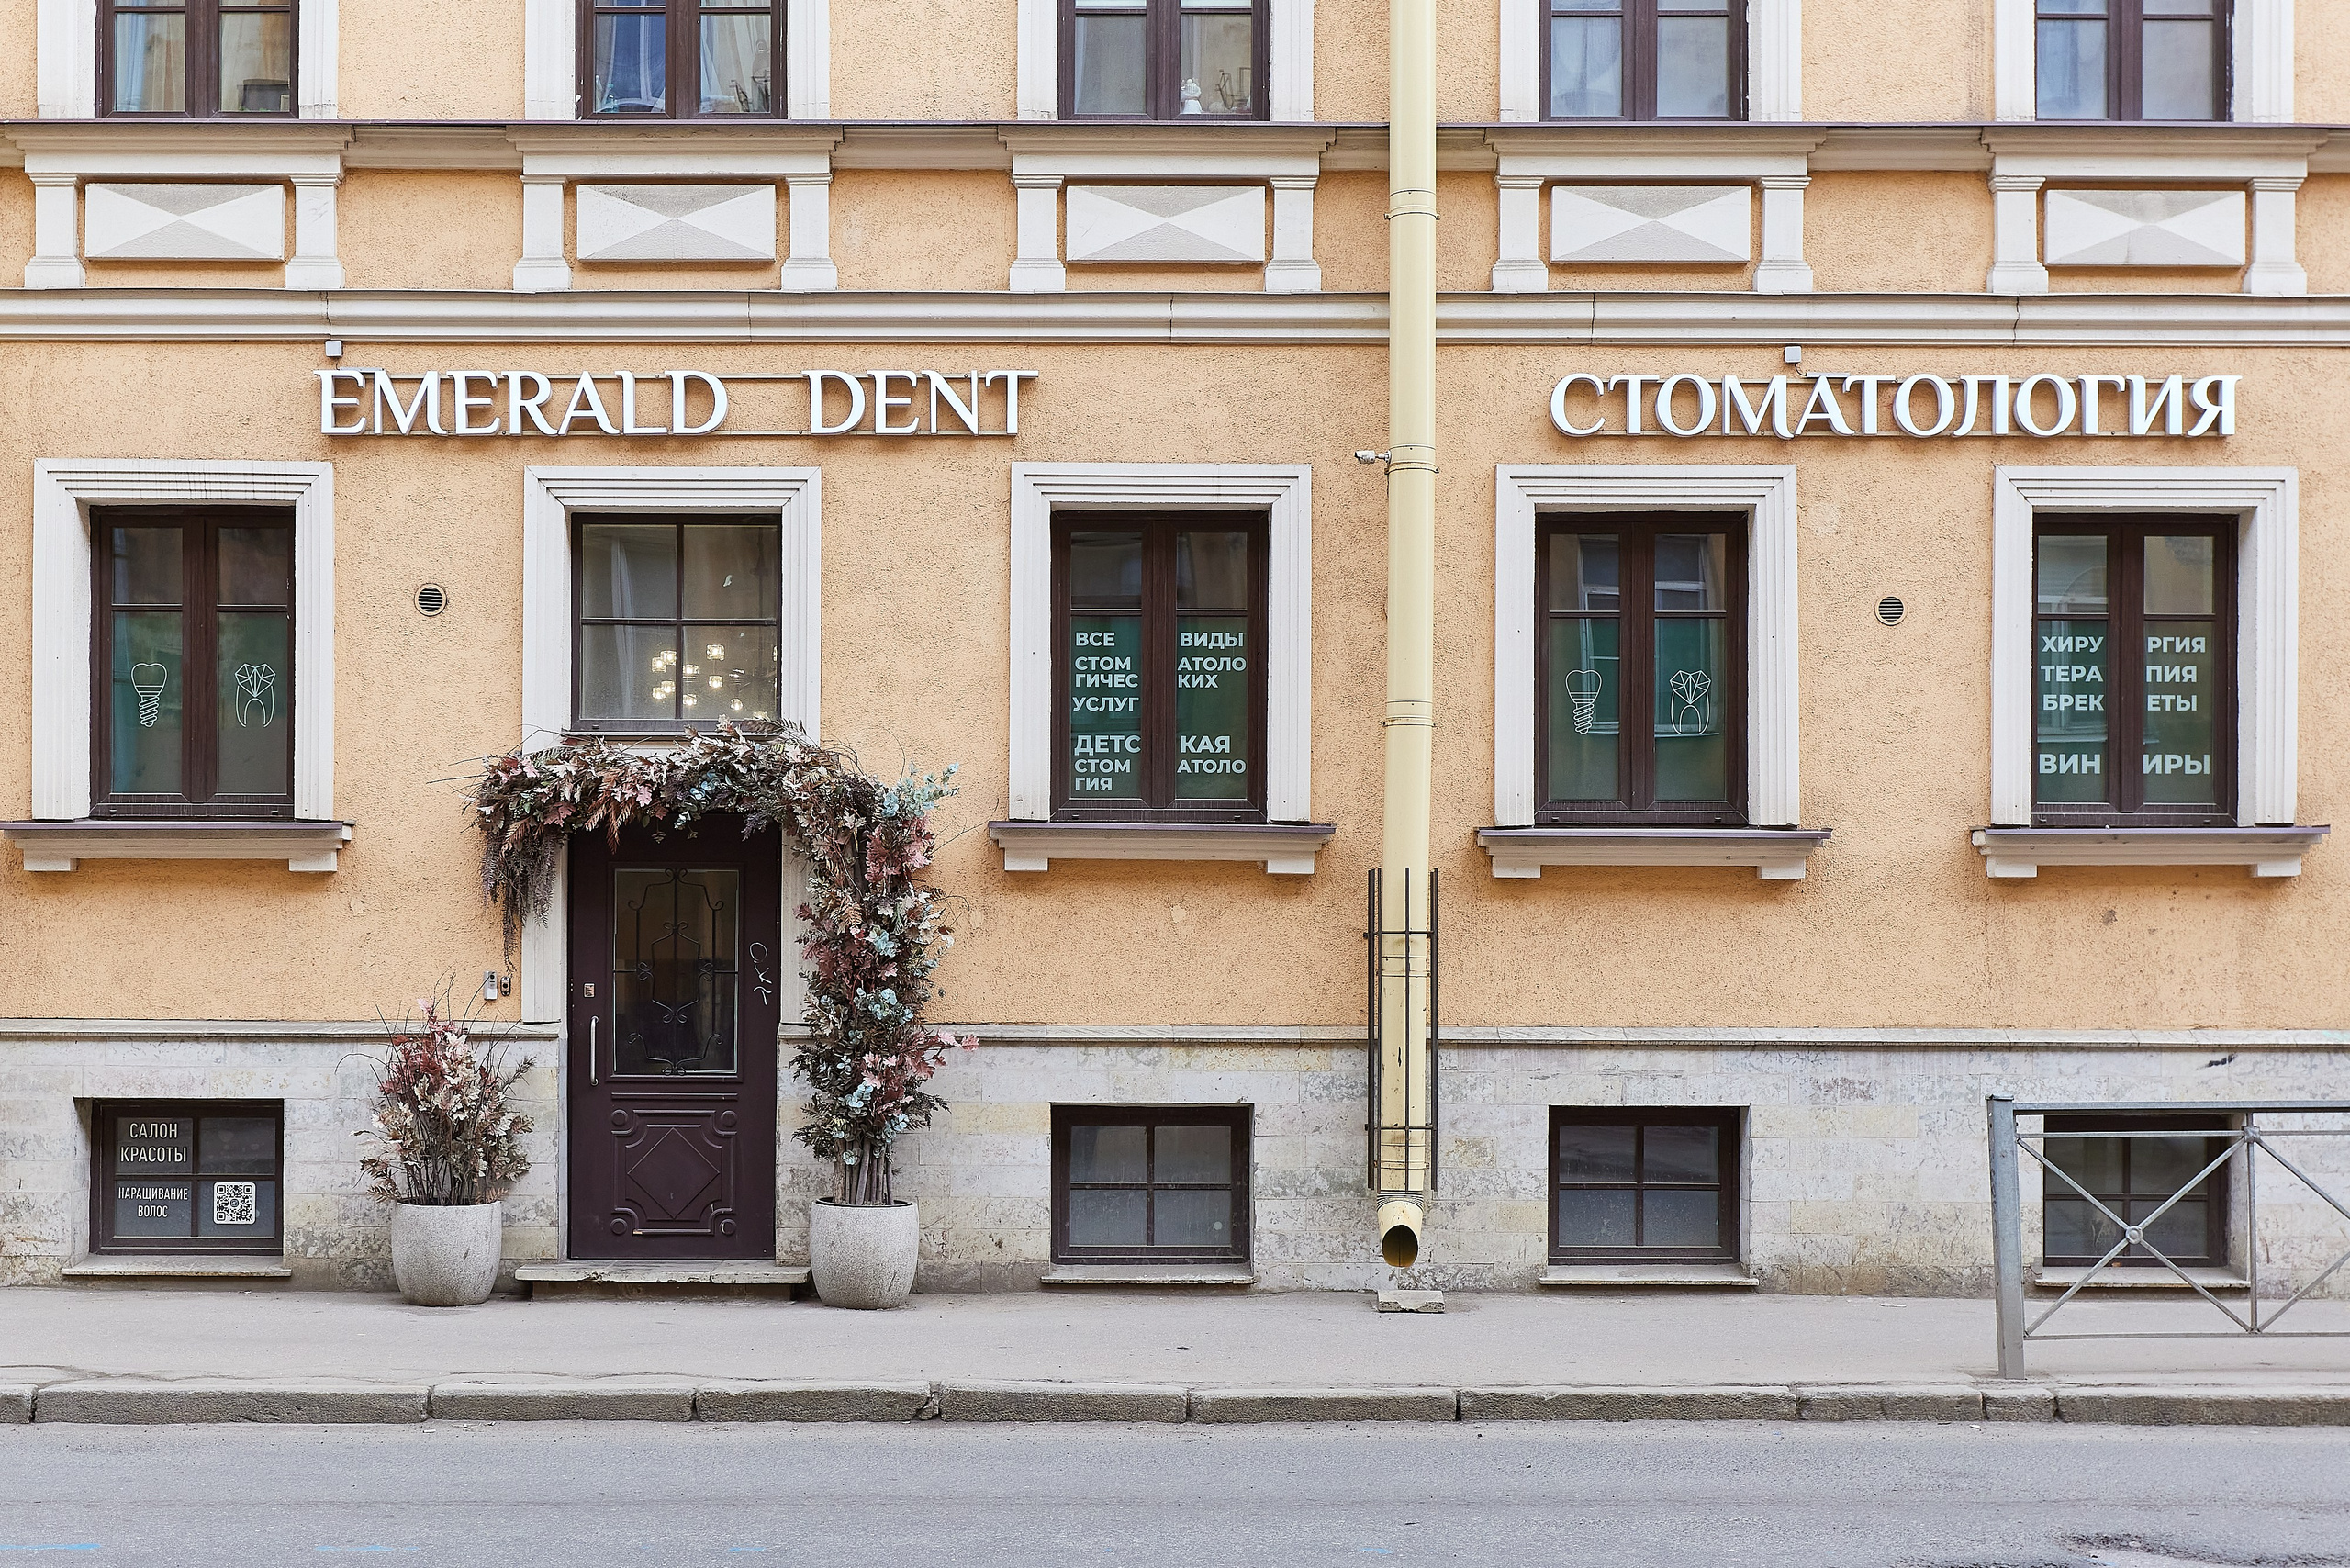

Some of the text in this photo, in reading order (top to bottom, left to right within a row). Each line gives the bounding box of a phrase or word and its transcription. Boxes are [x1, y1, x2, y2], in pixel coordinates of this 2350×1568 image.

[313, 369, 1040, 436] EMERALD DENT
[1549, 372, 2244, 440] СТОМАТОЛОГИЯ
[1075, 632, 1244, 650] ВСЕ ВИДЫ
[2042, 636, 2206, 653] ХИРУ РГИЯ
[1074, 656, 1247, 671] СТОМ АТОЛО
[1075, 673, 1219, 689] ГИЧЕС КИХ
[2040, 665, 2198, 683] ТЕРА ПИЯ
[1072, 696, 1139, 711] УСЛУГ
[2042, 694, 2198, 711] БРЕК ЕТЫ
[1074, 734, 1231, 756] ДЕТС КАЯ
[1074, 758, 1247, 774] СТОМ АТОЛО
[2039, 754, 2210, 775] ВИН ИРЫ
[1075, 777, 1113, 791] ГИЯ
[129, 1123, 178, 1138] САЛОН
[120, 1147, 187, 1162] КРАСОТЫ
[118, 1187, 188, 1201] НАРАЩИВАНИЕ
[138, 1205, 168, 1217] ВОЛОС
